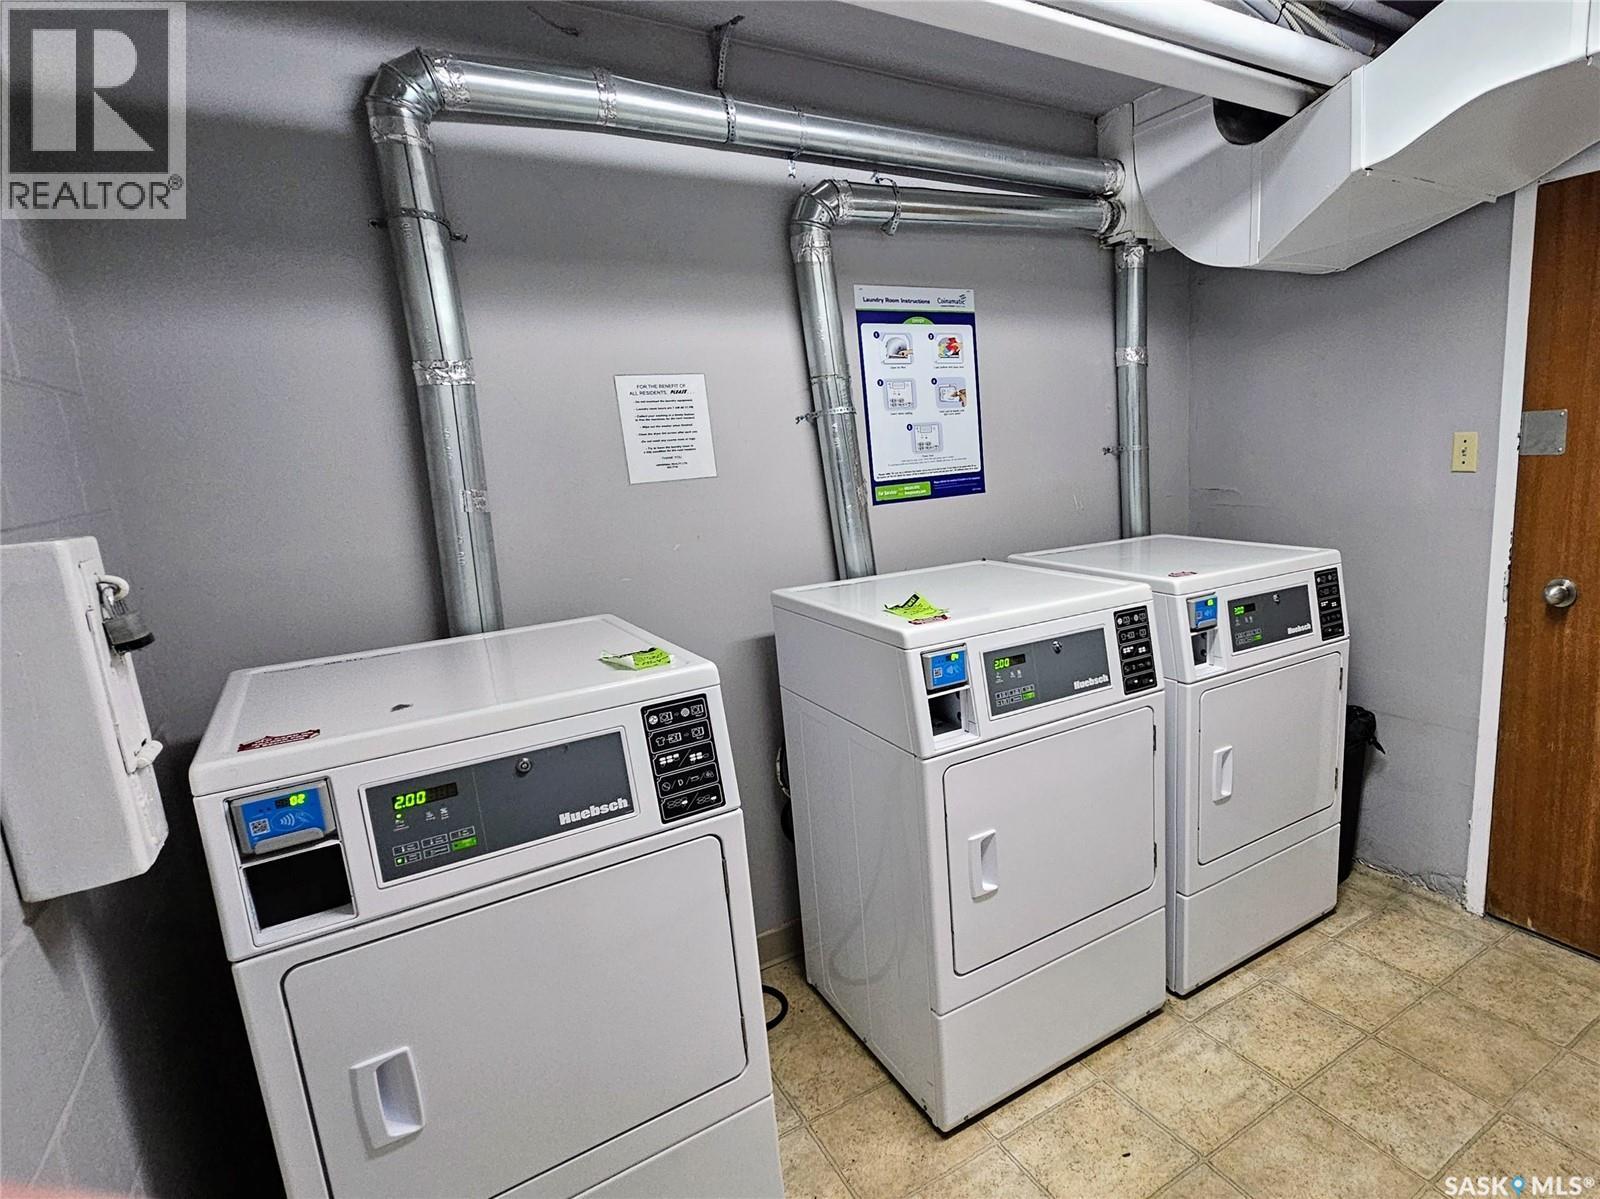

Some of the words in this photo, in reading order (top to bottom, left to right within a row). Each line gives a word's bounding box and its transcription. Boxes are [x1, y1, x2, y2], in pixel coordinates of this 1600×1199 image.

[862, 296, 884, 304] Laundry
[1073, 673, 1109, 690] Huebsch
[394, 790, 427, 810] 2.00
[558, 797, 629, 826] Huebsch
